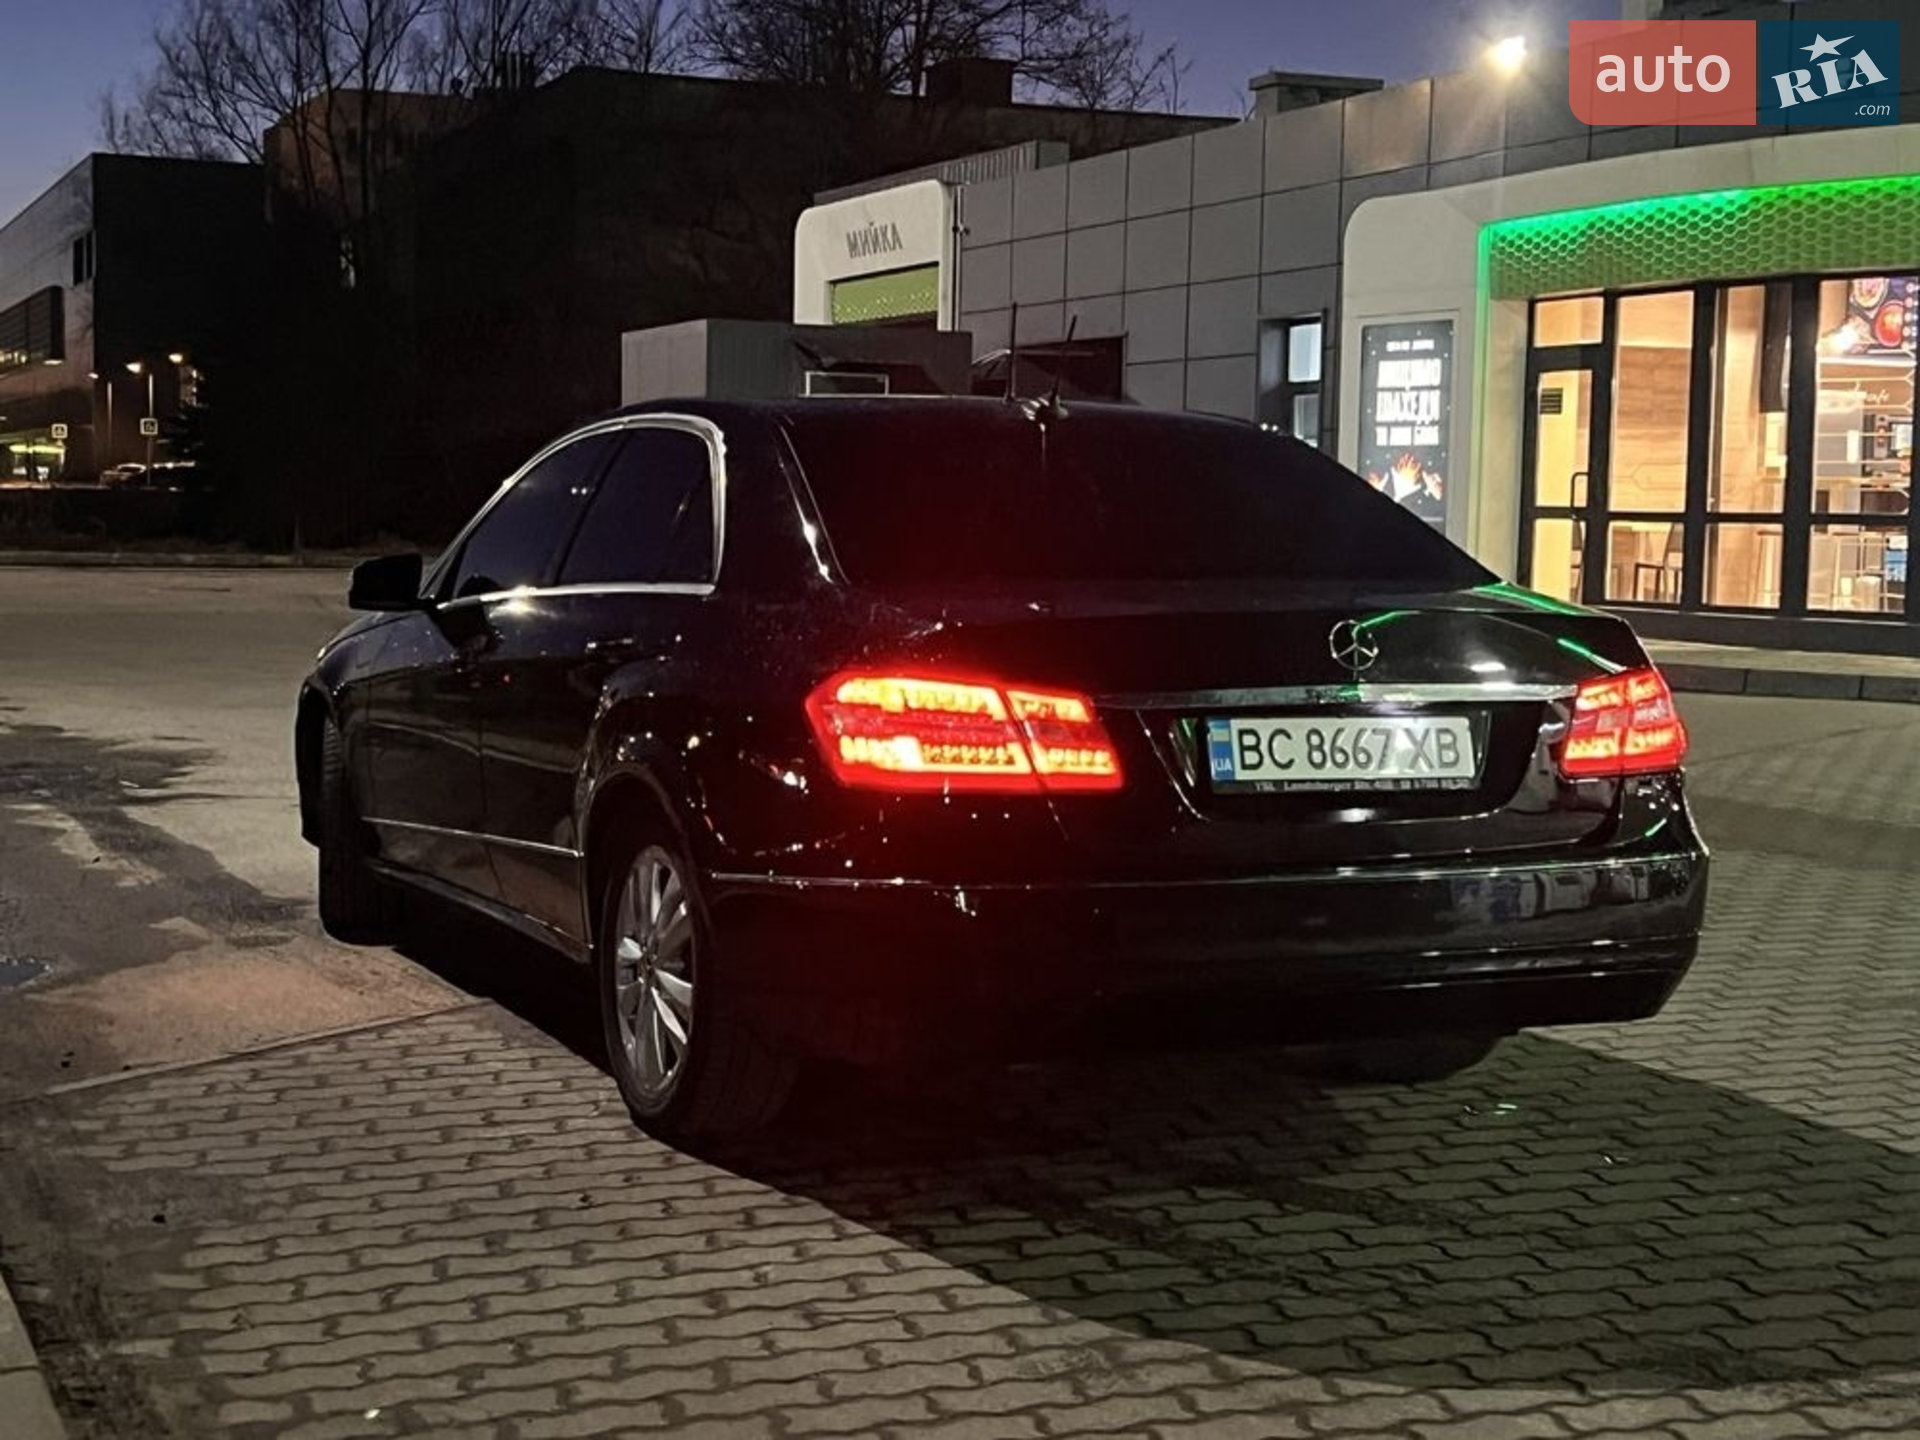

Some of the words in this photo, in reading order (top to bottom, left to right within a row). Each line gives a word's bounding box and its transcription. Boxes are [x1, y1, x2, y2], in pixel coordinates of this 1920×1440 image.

[846, 221, 903, 259] МИЙКА
[1214, 759, 1232, 772] UA
[1237, 728, 1295, 771] BC
[1305, 727, 1392, 770] 8667
[1403, 727, 1460, 770] XB
